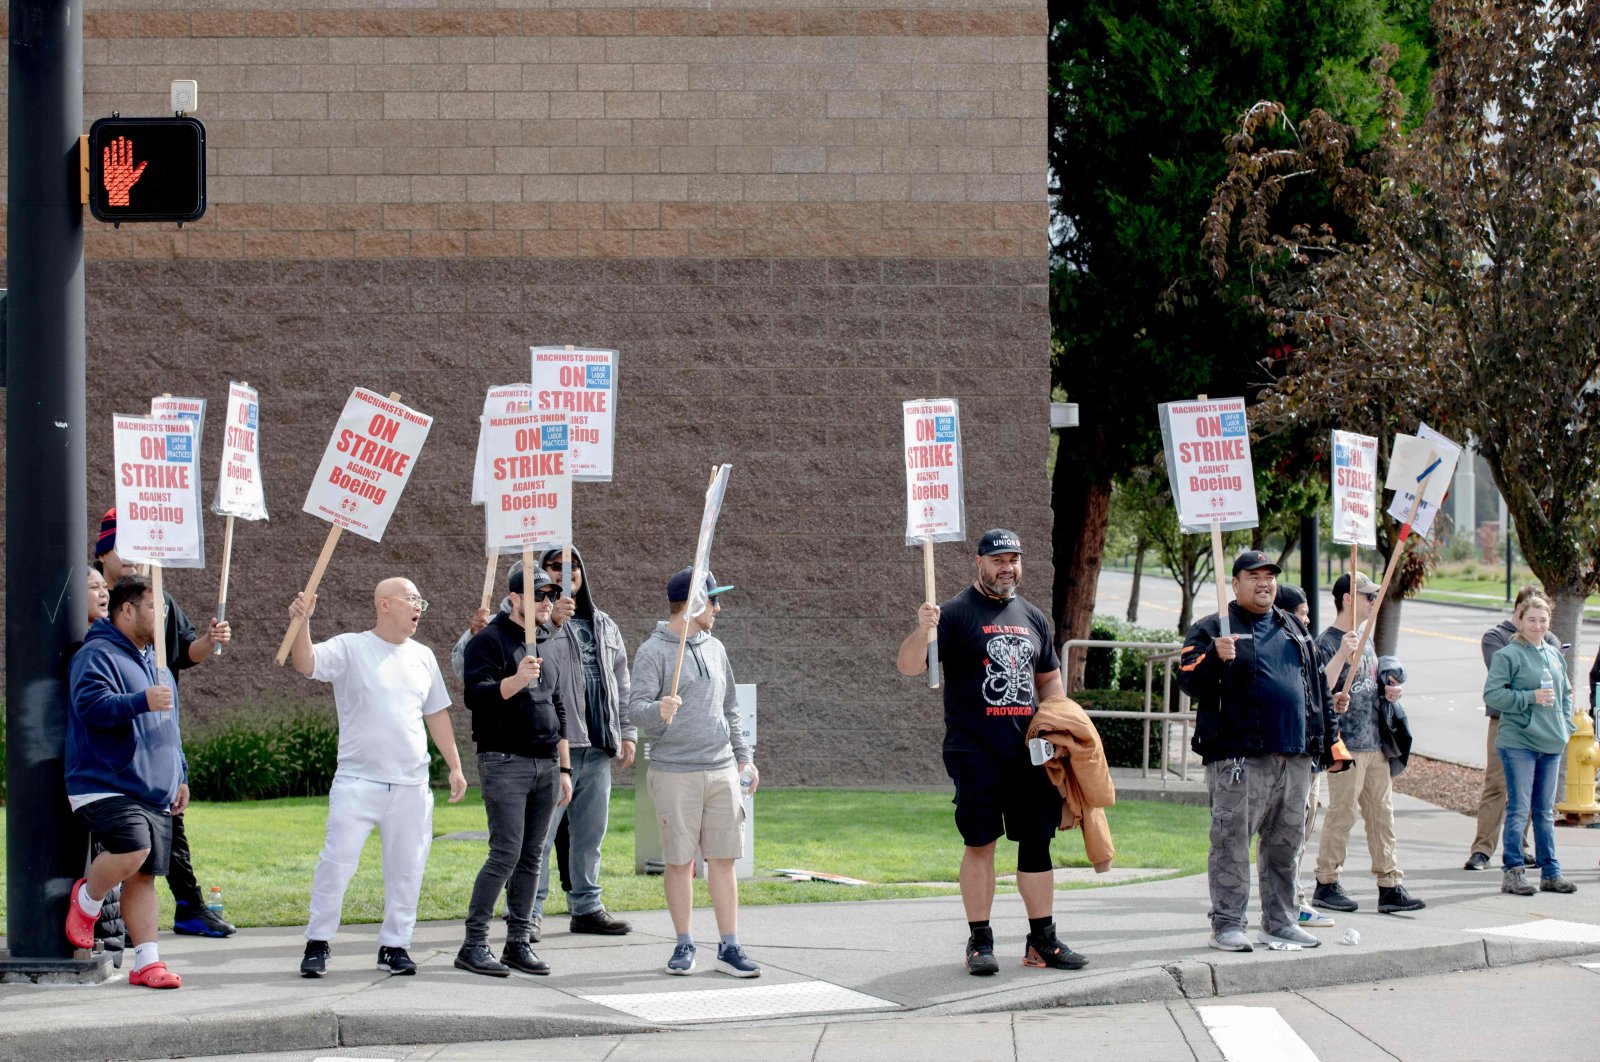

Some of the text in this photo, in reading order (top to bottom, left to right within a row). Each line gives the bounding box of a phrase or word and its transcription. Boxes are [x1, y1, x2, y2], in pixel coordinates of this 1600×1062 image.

[537, 354, 583, 362] MACHINISTS
[560, 366, 585, 387] ON
[179, 403, 199, 411] UNION
[239, 402, 248, 424] ON
[355, 392, 428, 428] MACHINISTS UNION
[539, 391, 606, 413] STRIKE
[1172, 403, 1241, 414] MACHINISTS UNION
[118, 421, 190, 432] MACHINISTS UNION
[368, 414, 400, 443] ON
[490, 414, 566, 426] MACHINISTS UNION
[916, 419, 935, 442] ON
[1196, 416, 1221, 438] ON
[228, 426, 254, 452] STRIKE
[515, 428, 540, 452] ON
[570, 426, 599, 444] eing
[140, 436, 165, 460] ON
[337, 429, 410, 477] STRIKE
[908, 444, 953, 469] STRIKE
[1179, 439, 1245, 463] STRIKE
[121, 463, 189, 489] STRIKE
[227, 461, 252, 483] Boeing
[347, 462, 382, 482] AGAINST
[494, 453, 564, 480] STRIKE
[1199, 465, 1229, 474] AGAINST
[329, 466, 387, 506] Boeing
[513, 480, 545, 491] AGAINST
[1190, 475, 1242, 492] Boeing
[1338, 468, 1372, 491] STRIKE
[139, 492, 171, 502] AGAINST
[502, 491, 558, 511] Boeing
[913, 482, 949, 500] Boeing
[129, 502, 183, 524] Boeing
[1342, 498, 1368, 518] Boeing
[982, 625, 1029, 635] WILL STRIKE
